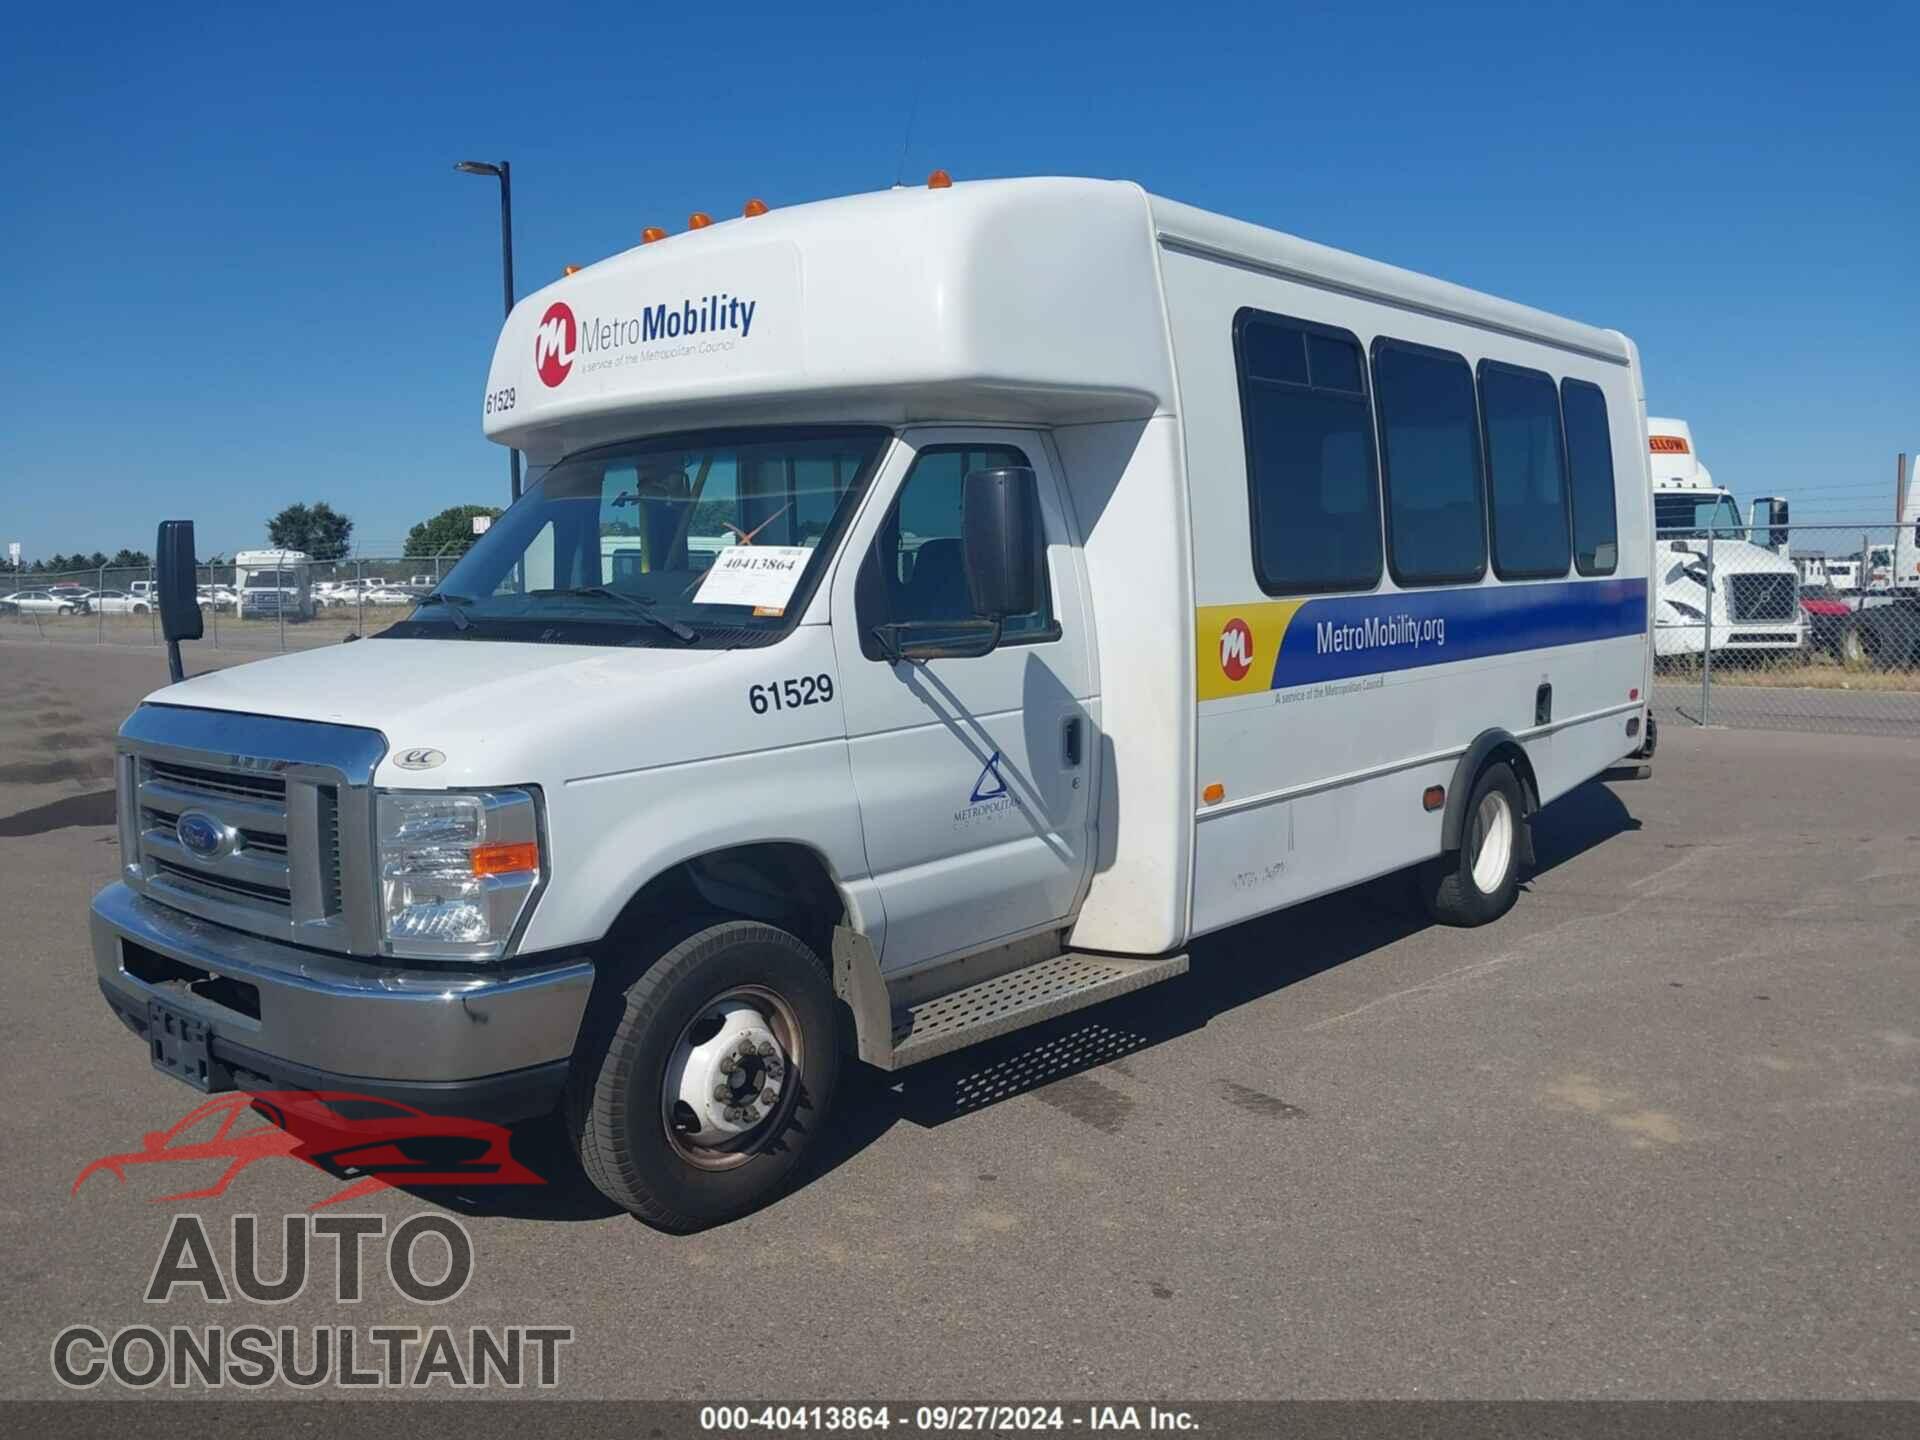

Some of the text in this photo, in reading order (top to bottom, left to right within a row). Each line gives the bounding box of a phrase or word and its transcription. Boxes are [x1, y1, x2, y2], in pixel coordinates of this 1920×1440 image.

[580, 293, 756, 354] MetroMobility
[486, 387, 516, 415] 61529
[1649, 439, 1683, 450] ELLOW
[722, 558, 796, 571] 40413864
[1316, 614, 1446, 655] MetroMobility.org
[749, 673, 834, 714] 61529
